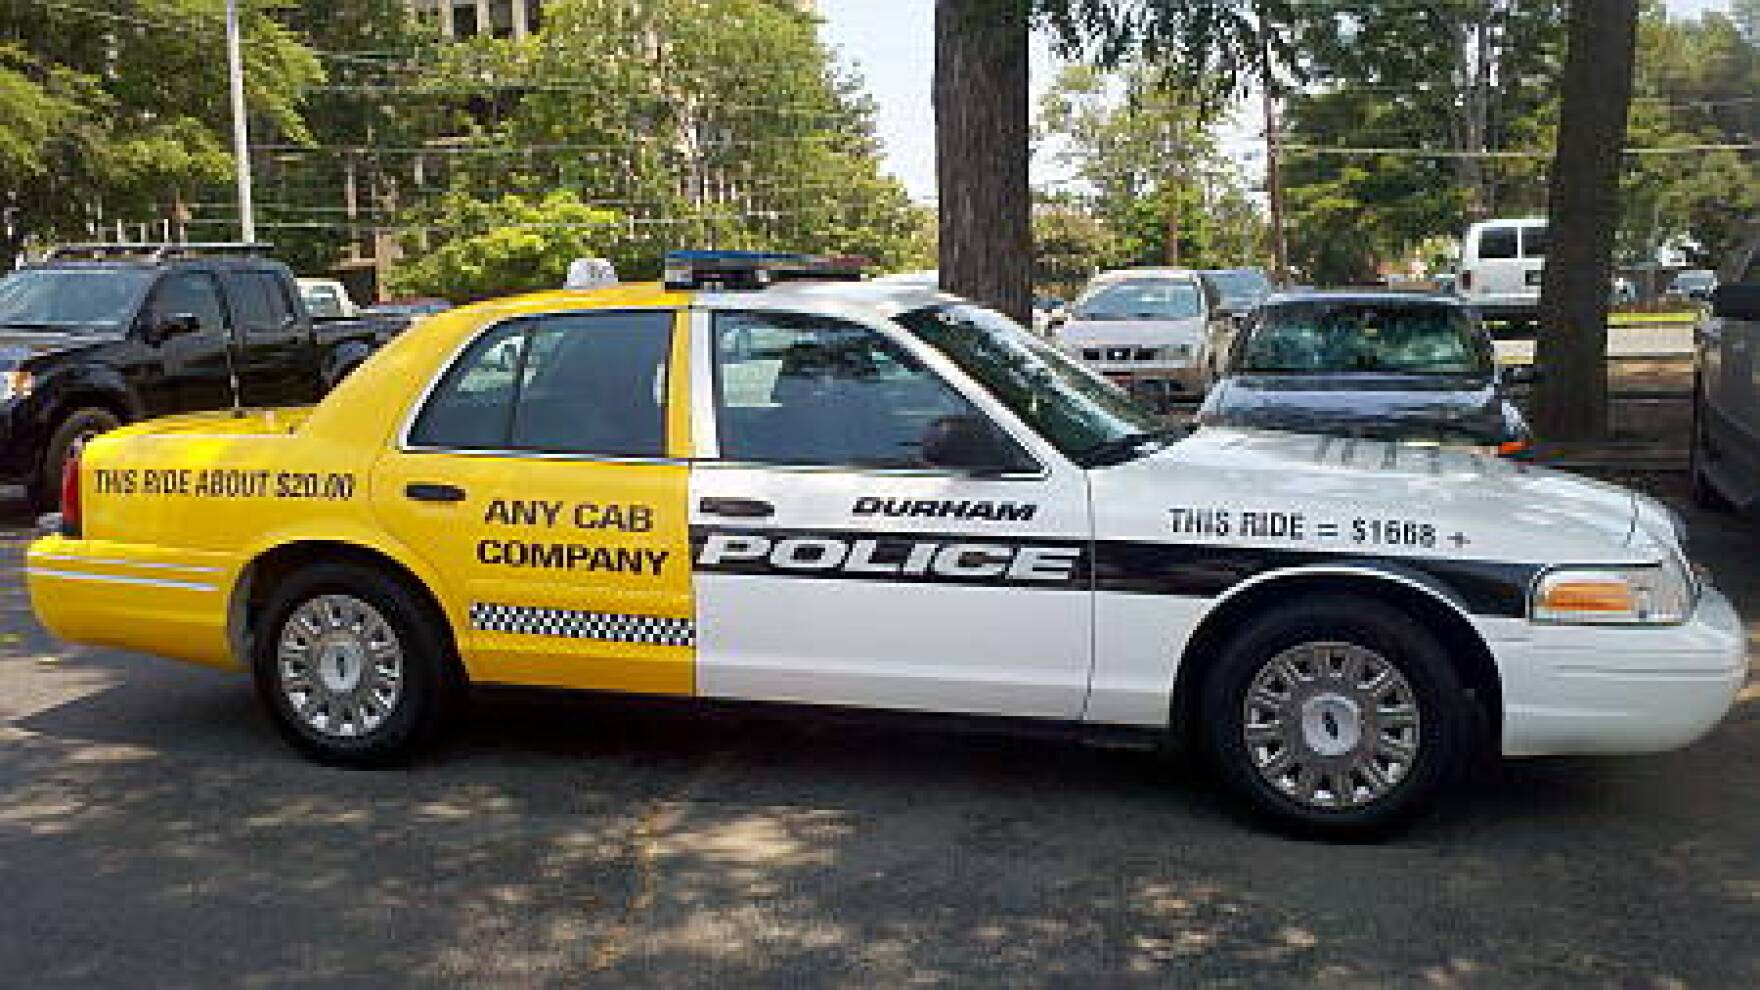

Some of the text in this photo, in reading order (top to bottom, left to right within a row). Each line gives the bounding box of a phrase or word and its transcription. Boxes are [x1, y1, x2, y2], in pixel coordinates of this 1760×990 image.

[195, 469, 270, 498] ABOUT
[275, 471, 356, 501] $20.00
[484, 500, 654, 532] ANY CAB
[852, 496, 1037, 521] DURHAM
[1169, 508, 1229, 536] THIS
[1240, 511, 1304, 540] RIDE
[1352, 516, 1437, 548] $1668
[477, 539, 669, 576] COMPANY
[699, 535, 1081, 580] POLICE
